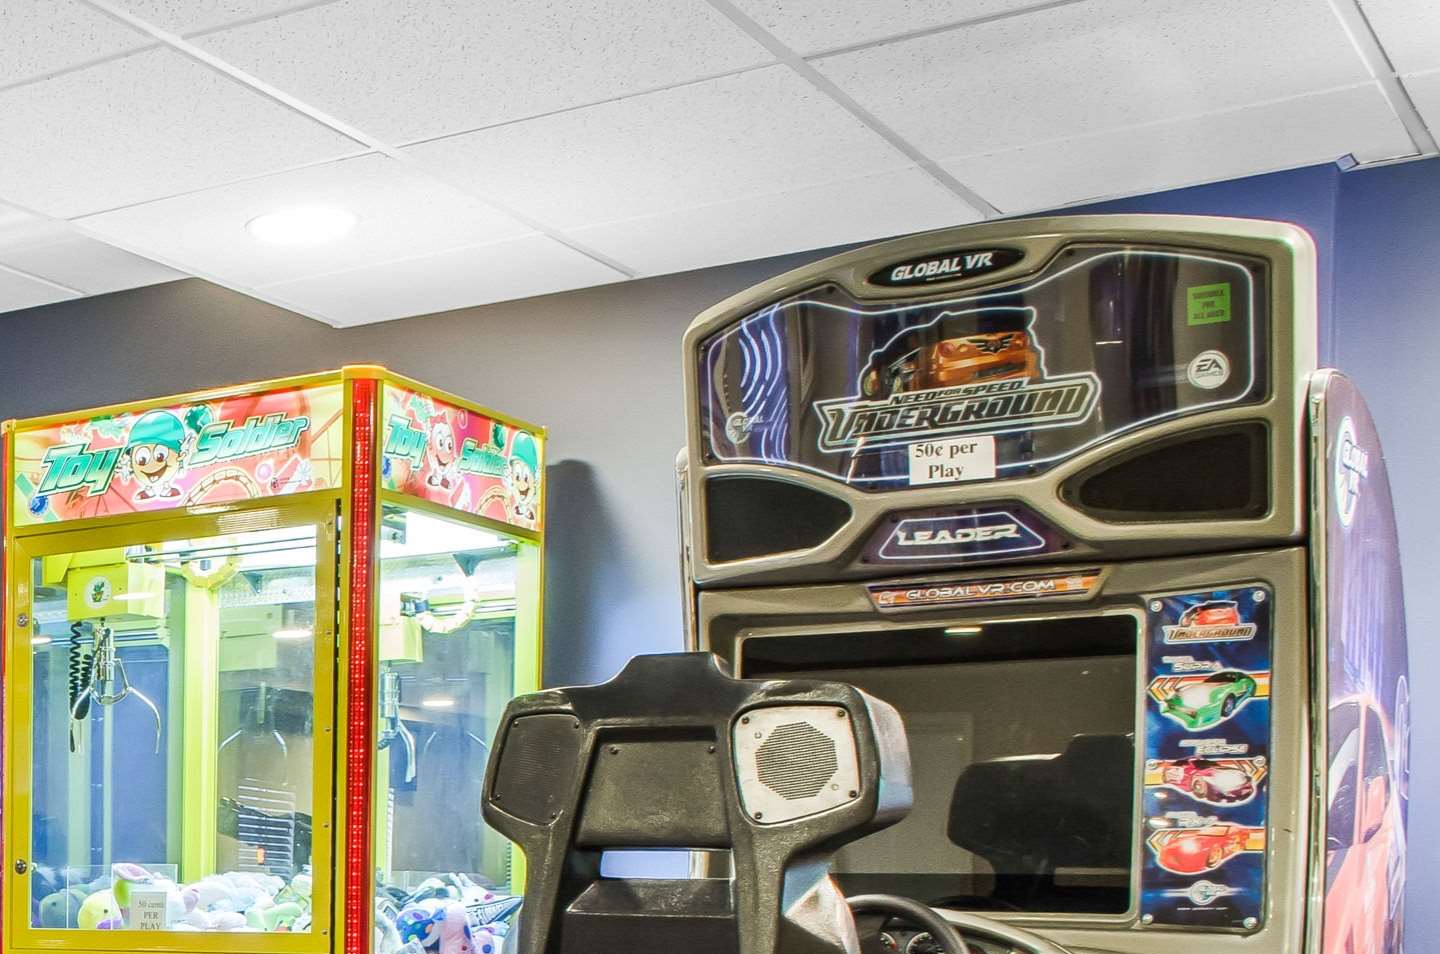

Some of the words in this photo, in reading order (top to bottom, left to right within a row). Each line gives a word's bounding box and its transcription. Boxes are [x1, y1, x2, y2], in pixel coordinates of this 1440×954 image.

[890, 256, 962, 282] GLOBAL
[964, 251, 994, 270] VR
[1196, 358, 1223, 373] EA
[889, 392, 937, 406] NEED
[937, 388, 962, 398] FOR
[962, 379, 1026, 396] SPEED
[822, 383, 1090, 440] UNDERGROUND
[385, 413, 427, 470] Toy
[914, 443, 945, 458] 50¢
[949, 442, 978, 458] per
[38, 442, 124, 496] Toy
[190, 412, 309, 466] Soldier
[927, 462, 965, 481] Play
[895, 523, 1022, 546] LEADER
[140, 922, 161, 930] PLAY
[143, 911, 160, 920] PER
